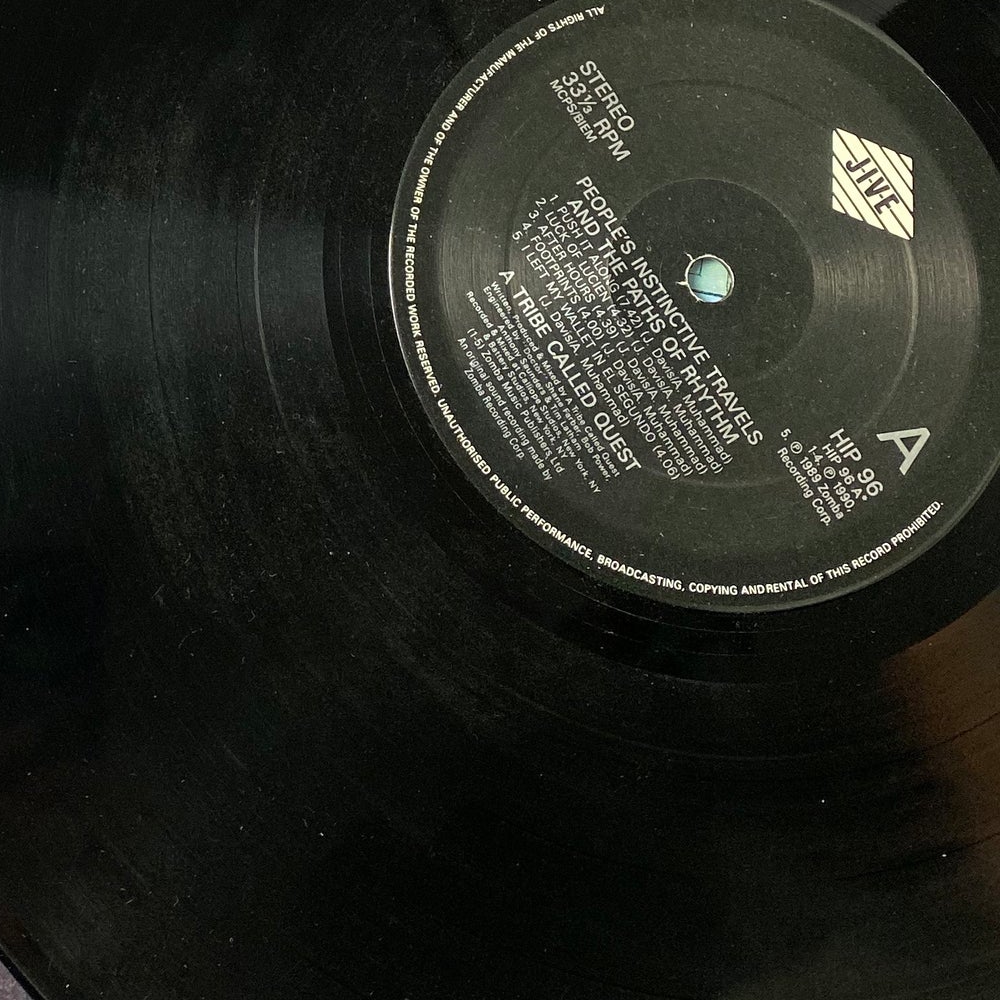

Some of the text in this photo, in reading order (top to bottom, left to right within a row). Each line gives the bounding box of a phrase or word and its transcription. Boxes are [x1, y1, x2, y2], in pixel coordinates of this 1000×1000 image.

[549, 79, 598, 143] MCPS/BIEM
[579, 60, 635, 132] STEREO
[592, 117, 631, 162] RPM
[405, 4, 944, 596] ALL RIGHTS OF THE MANUFACTURER AND OF THE OWNER OF THE RECORDED WORK RESERVED. UNAUTHORISED PUBLIC PERFORMANCE, BROADCASTING, COPYING AND RENTAL OF THIS RECORD PROHIBITED.
[528, 209, 620, 339] 3. AFTER HOURS (4.39)
[535, 197, 635, 338] 2. LUCK OF LUCIEN (4.32)
[566, 200, 740, 445] AND THE PATHS OF RHYTHM
[498, 270, 642, 471] A TRIBE CALLED QUEST
[525, 251, 551, 279] LEFT
[545, 281, 565, 300] MY
[560, 302, 597, 348] WALLET
[591, 350, 607, 366] IN
[602, 367, 616, 384] EL
[613, 384, 656, 443] SEGUNDO
[652, 444, 681, 480] (4.06)
[556, 205, 584, 239] PUSH
[579, 239, 594, 251] IT
[588, 255, 620, 293] ALONG
[616, 294, 644, 329] (7.42)
[651, 347, 683, 393] Davis/A.
[682, 393, 733, 465] Muhammad)
[630, 256, 711, 365] INSTINCTIVE
[706, 364, 763, 445] TRAVELS
[512, 314, 540, 352] Produced
[536, 352, 544, 361] &
[541, 360, 562, 386] Mixed
[557, 385, 568, 396] by
[571, 404, 586, 426] Tribe
[584, 426, 605, 452] Called
[601, 452, 620, 478] Quest
[876, 427, 931, 476] A
[777, 447, 831, 526] Recording Corp.
[780, 428, 792, 441] 5.
[799, 456, 822, 483] 1989
[817, 482, 844, 520] Zomba
[821, 443, 842, 464] HIP
[838, 467, 855, 485] 96
[829, 428, 884, 497] HIP 96
[833, 481, 855, 512] 1990,
